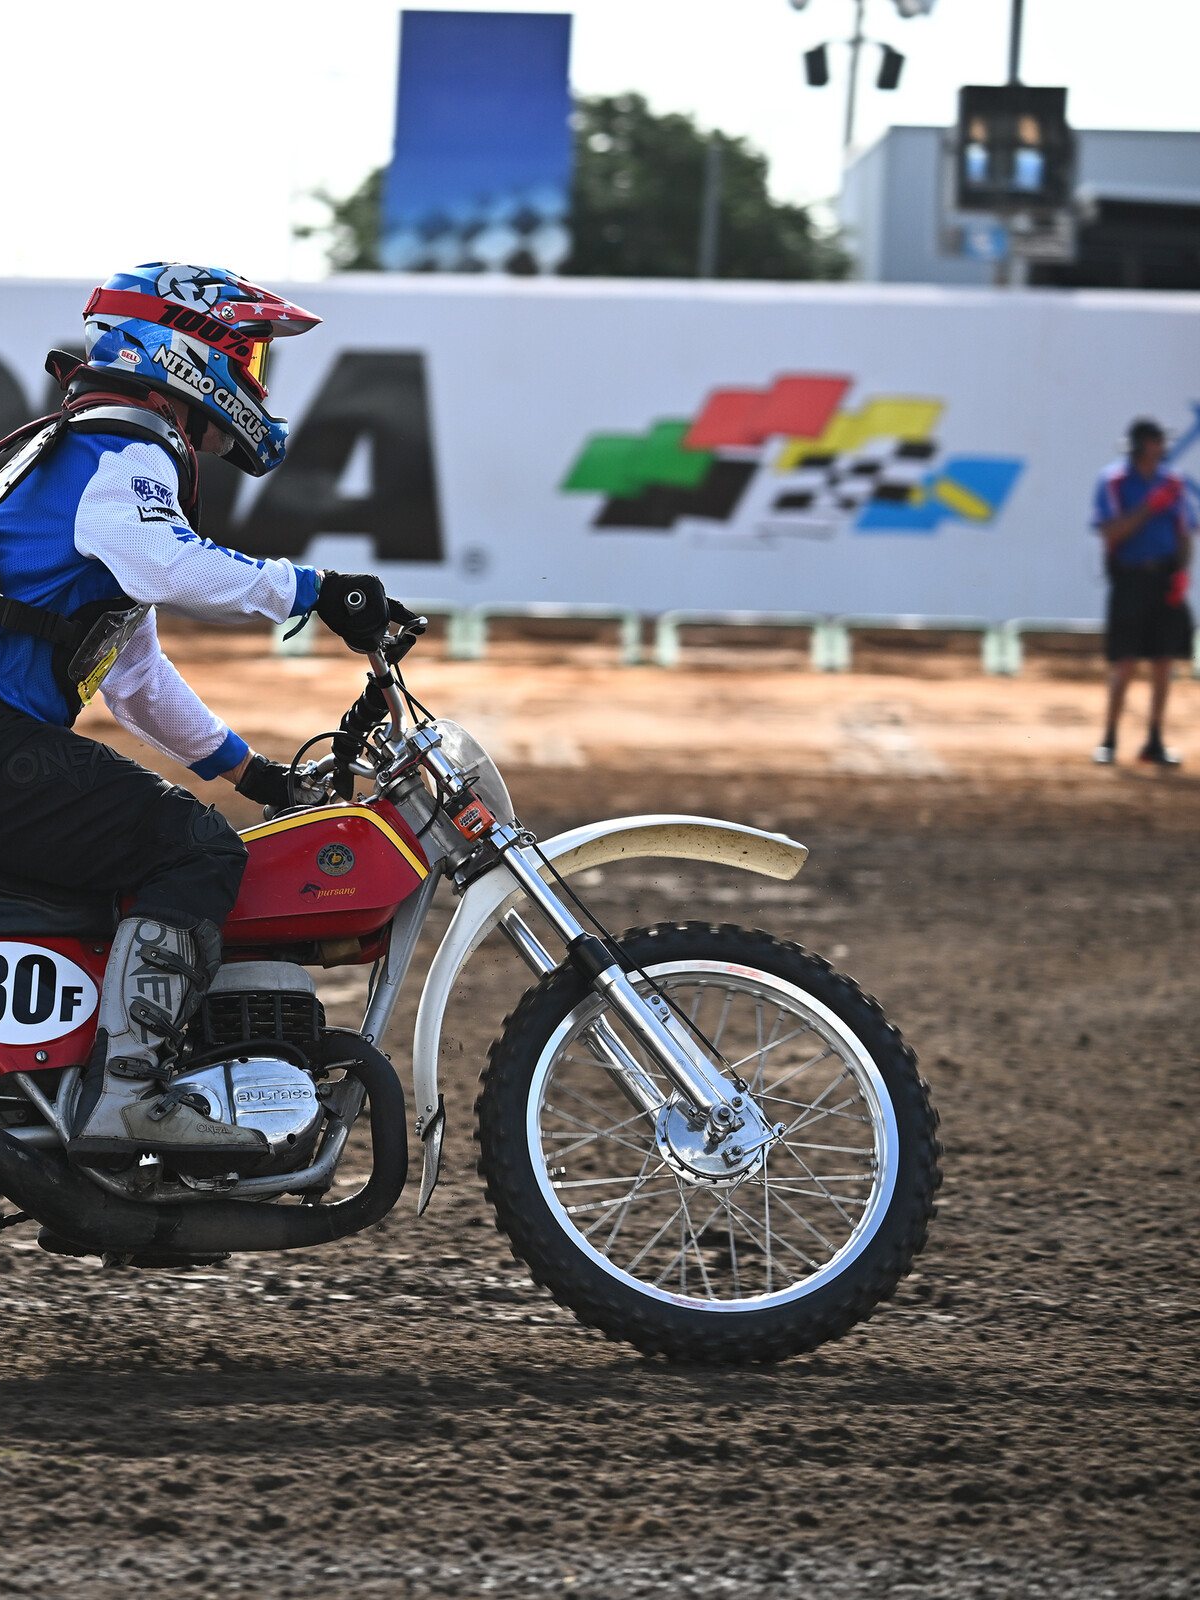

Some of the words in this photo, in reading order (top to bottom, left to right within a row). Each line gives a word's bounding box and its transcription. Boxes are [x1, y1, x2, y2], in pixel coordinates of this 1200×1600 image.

[157, 304, 251, 358] 100%
[120, 350, 139, 363] BELL
[152, 343, 216, 396] NITRO
[212, 386, 271, 444] CIRCUS
[317, 887, 356, 900] pursang
[237, 1088, 313, 1103] BULTACO
